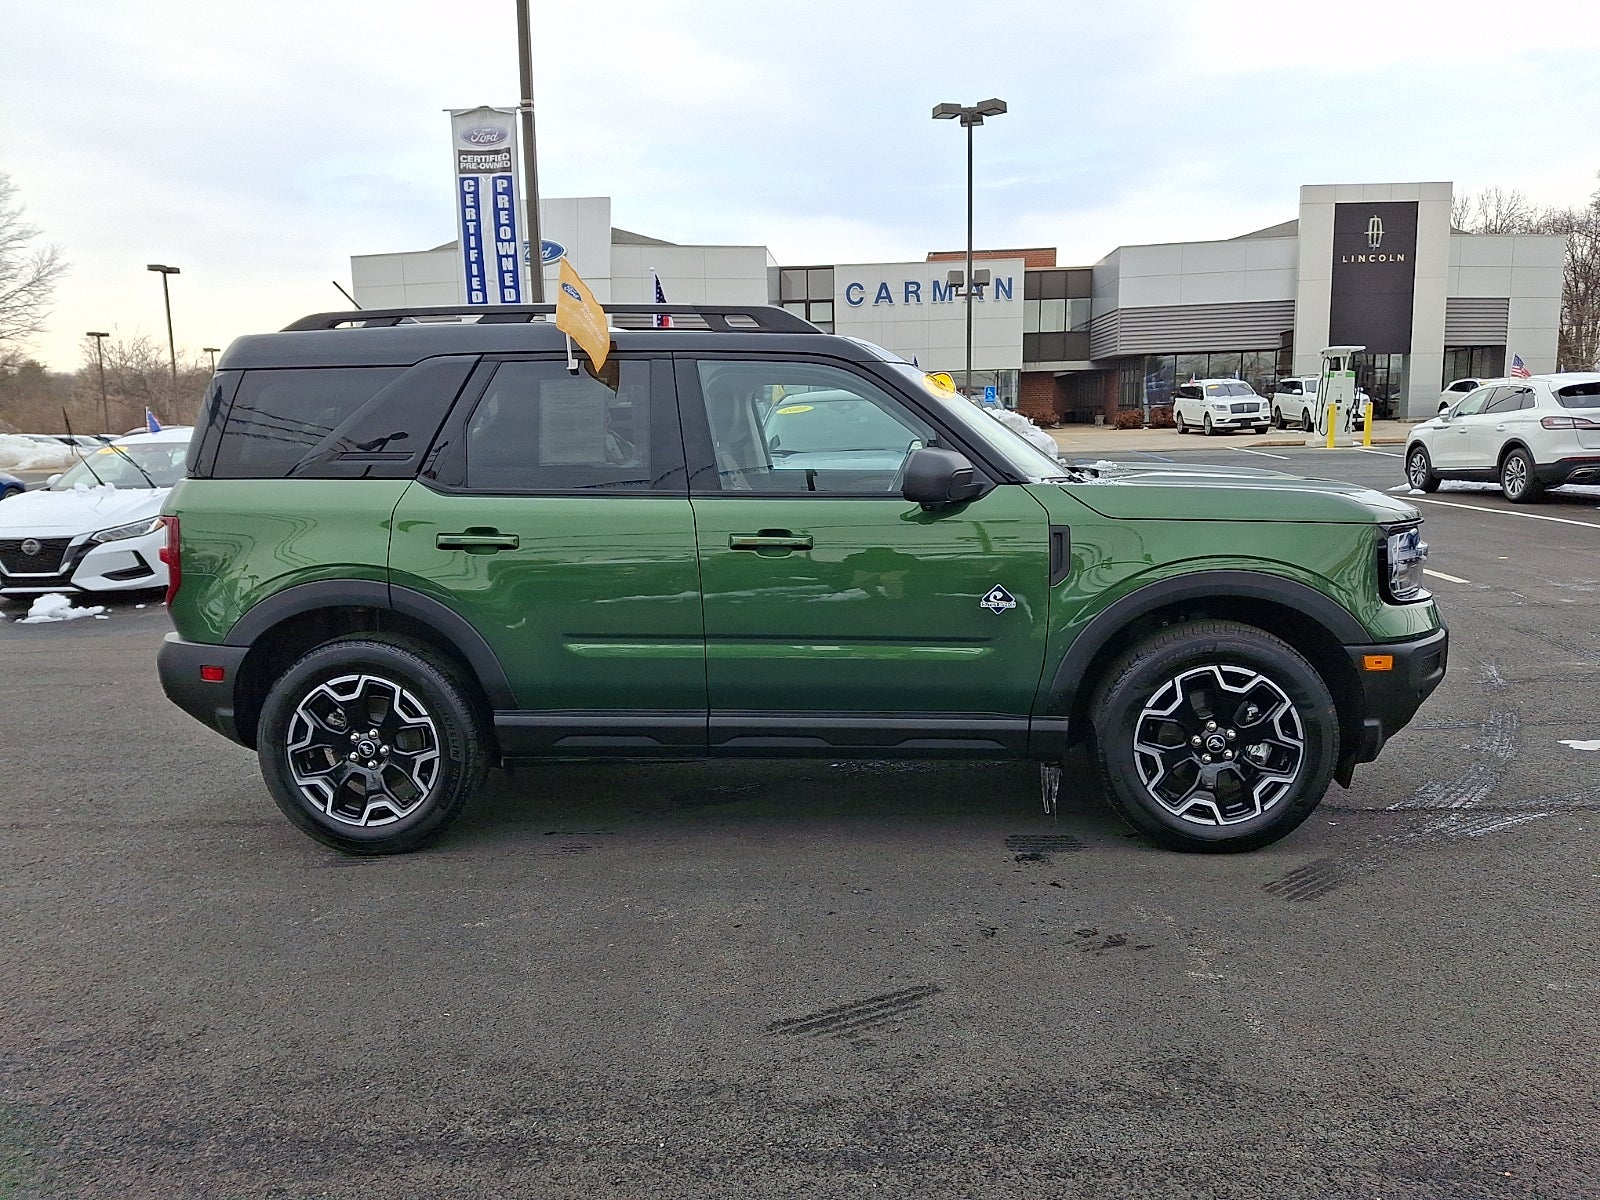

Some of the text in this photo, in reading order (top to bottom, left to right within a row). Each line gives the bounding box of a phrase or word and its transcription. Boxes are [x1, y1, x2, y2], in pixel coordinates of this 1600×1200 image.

[470, 129, 499, 143] Ford
[459, 152, 510, 163] CERTIFIED
[459, 161, 511, 170] PRE-OWNED
[463, 179, 484, 303] CERTIFIED
[496, 178, 516, 302] PREOWNED
[1342, 254, 1405, 263] LINCOLN
